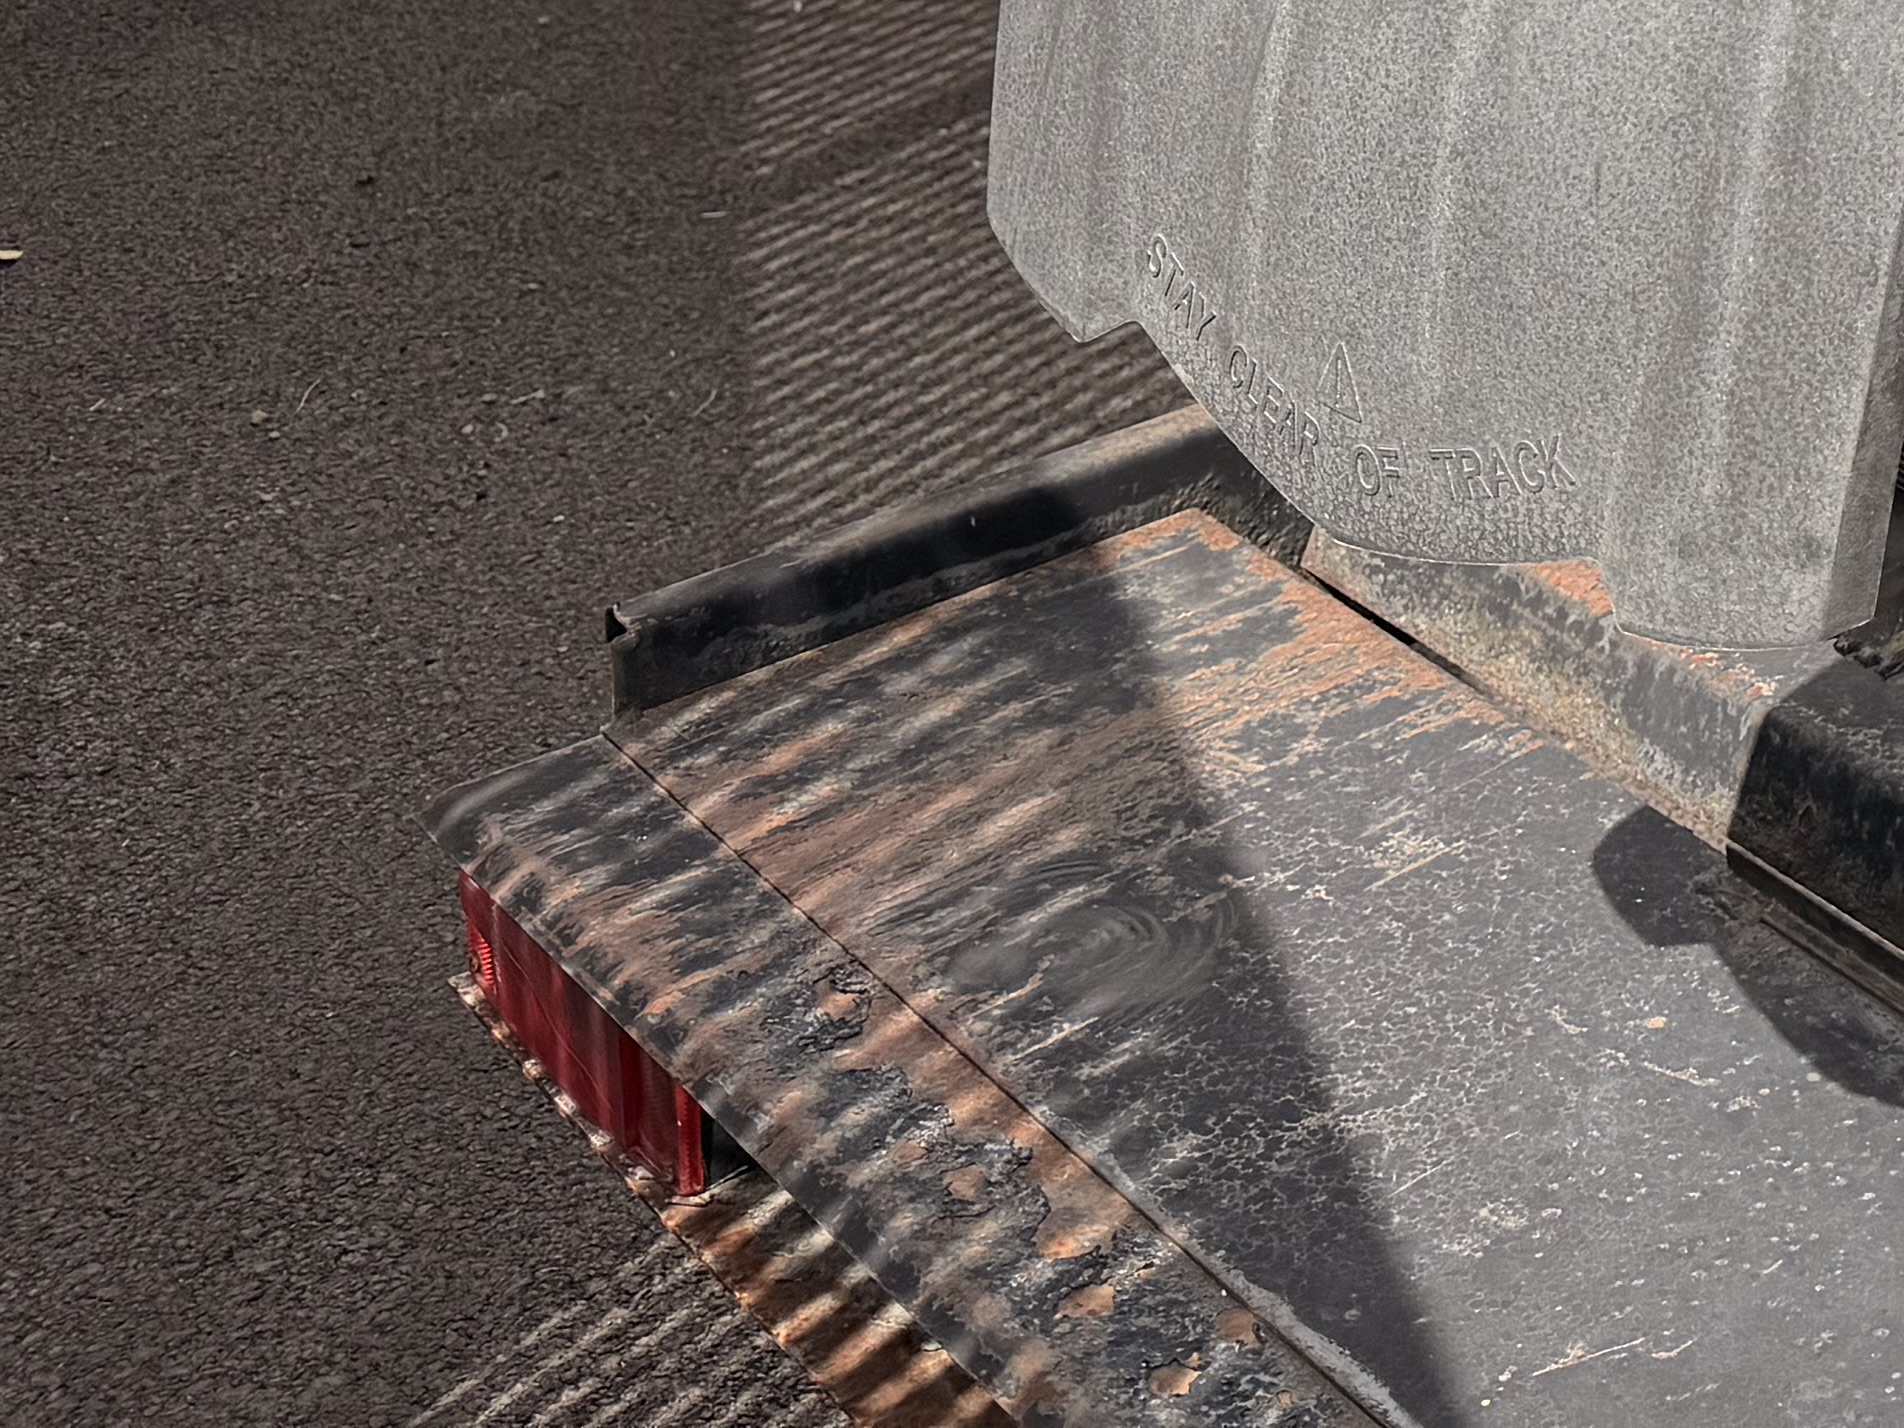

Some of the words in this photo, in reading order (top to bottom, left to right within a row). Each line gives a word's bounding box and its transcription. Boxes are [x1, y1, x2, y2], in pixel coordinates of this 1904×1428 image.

[1146, 233, 1217, 341] STAY
[1228, 343, 1320, 469] CLEAR
[1353, 443, 1401, 498] OF
[1429, 432, 1577, 502] TRACK
